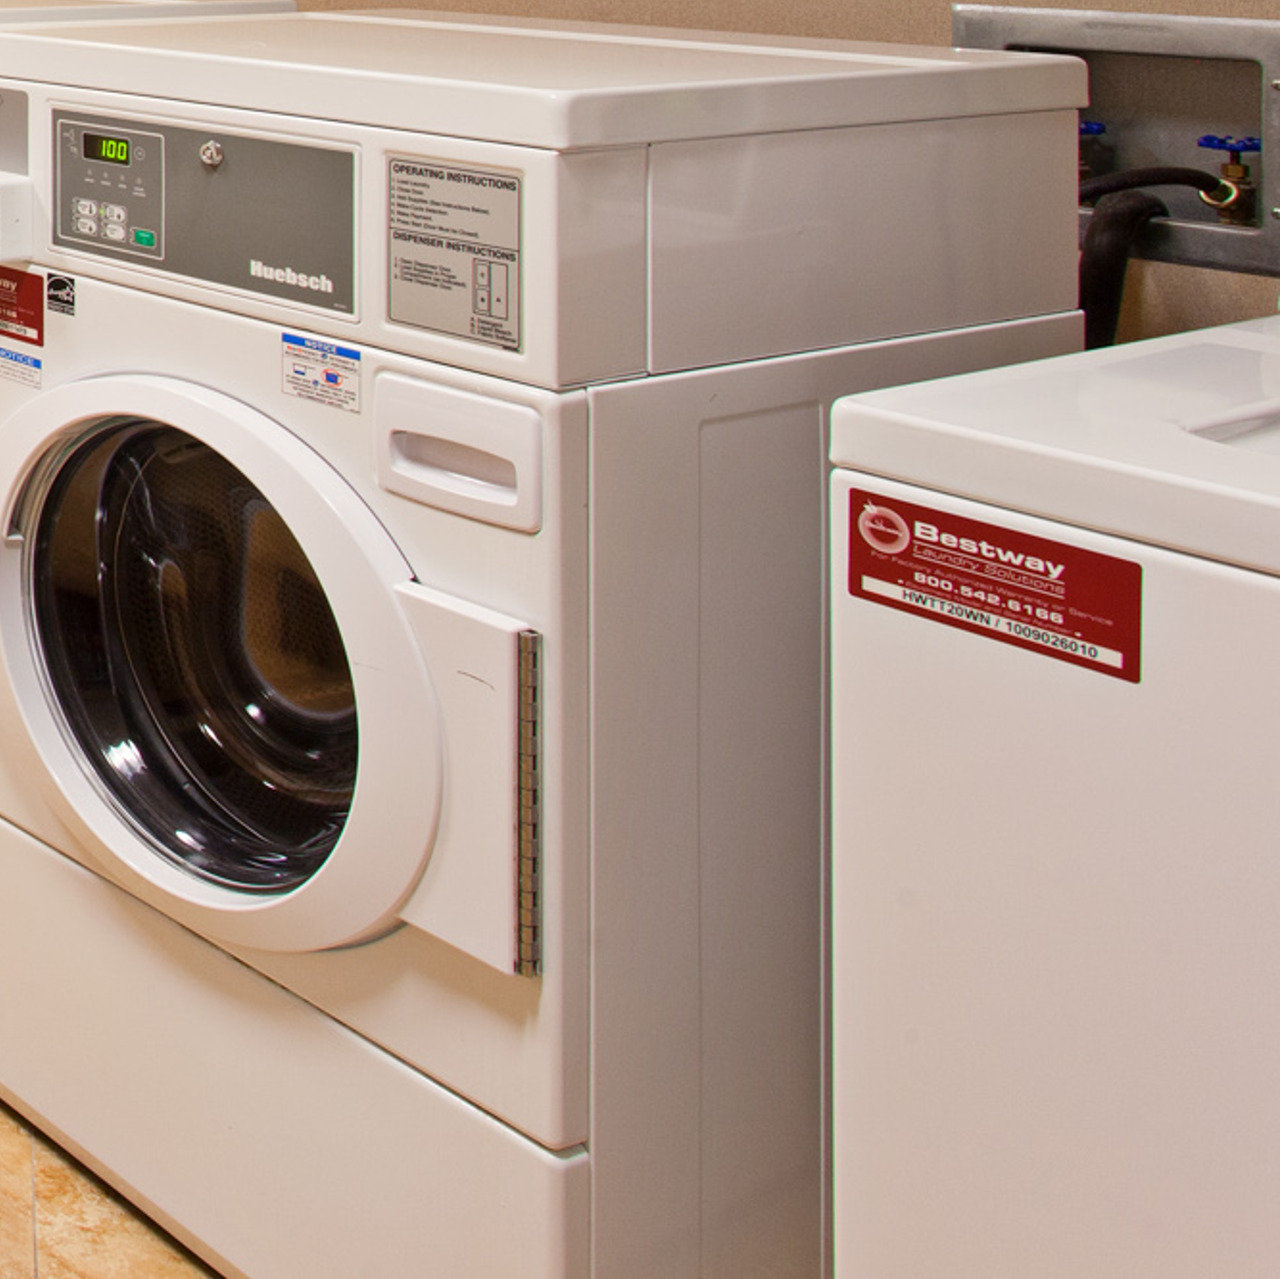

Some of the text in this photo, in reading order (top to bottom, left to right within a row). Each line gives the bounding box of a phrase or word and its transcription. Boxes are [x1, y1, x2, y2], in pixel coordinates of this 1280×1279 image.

[102, 140, 127, 160] 100
[392, 163, 517, 192] OPERATING INSTRUCTIONS
[392, 231, 517, 262] DISPENSER INSTRUCTIONS
[250, 259, 333, 293] Huebsch
[913, 520, 1065, 579] Bestway
[1006, 621, 1099, 659] 1009026010
